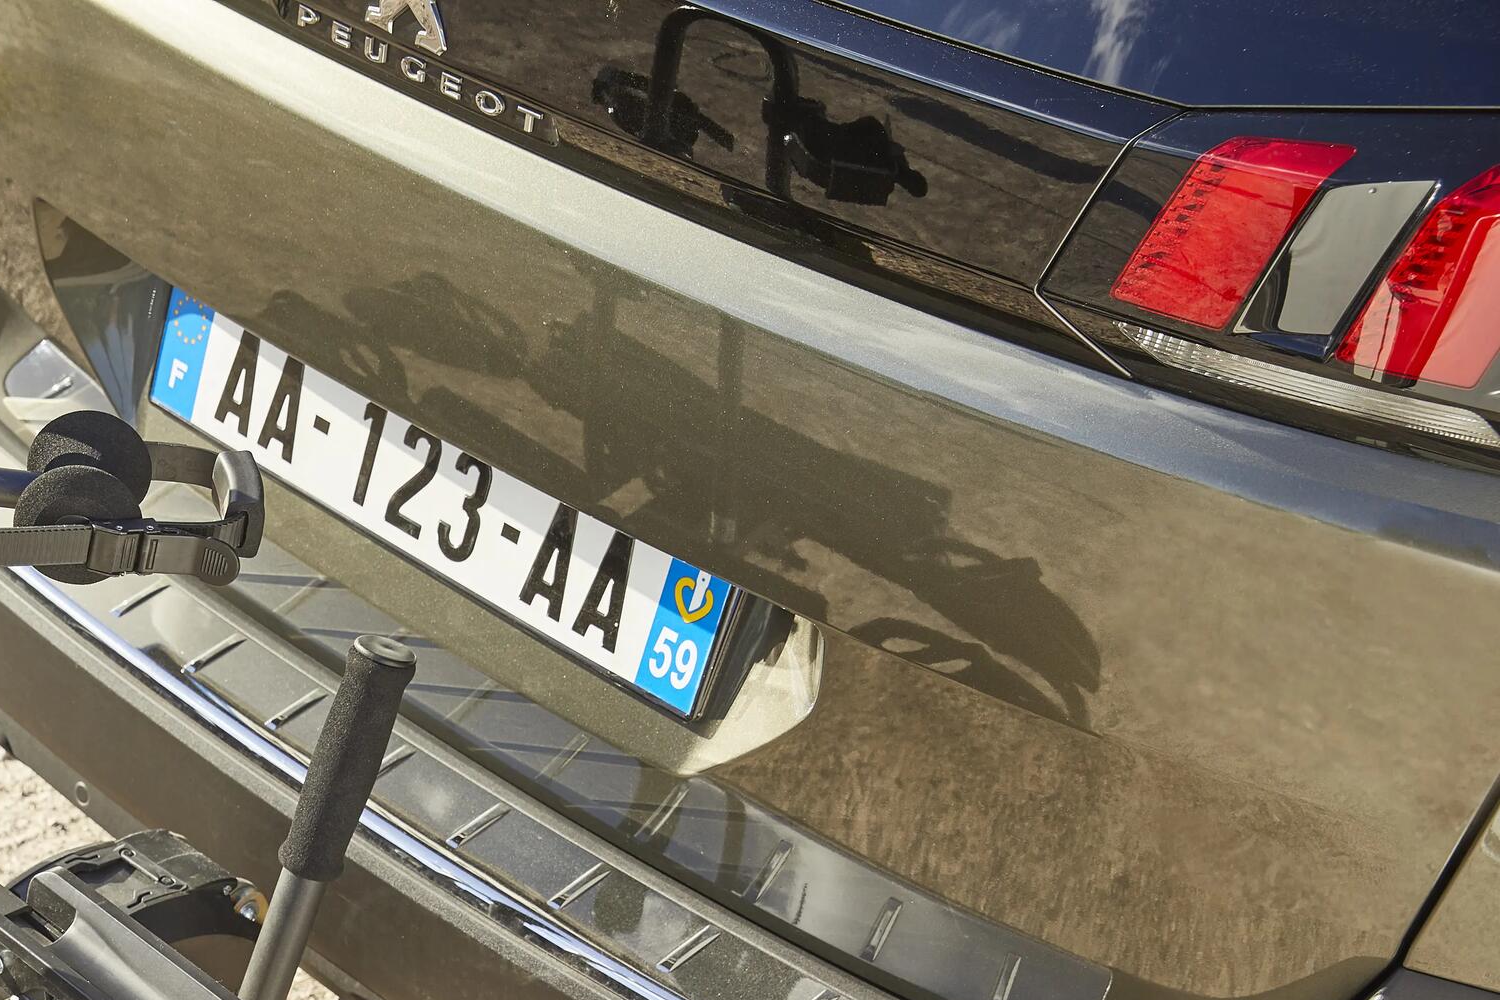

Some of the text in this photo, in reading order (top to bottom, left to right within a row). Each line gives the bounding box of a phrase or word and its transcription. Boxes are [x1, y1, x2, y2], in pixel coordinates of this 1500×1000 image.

[297, 4, 544, 133] PEUGEOT
[167, 358, 190, 389] F
[214, 329, 636, 654] AA-123-AA
[648, 626, 698, 690] 59
